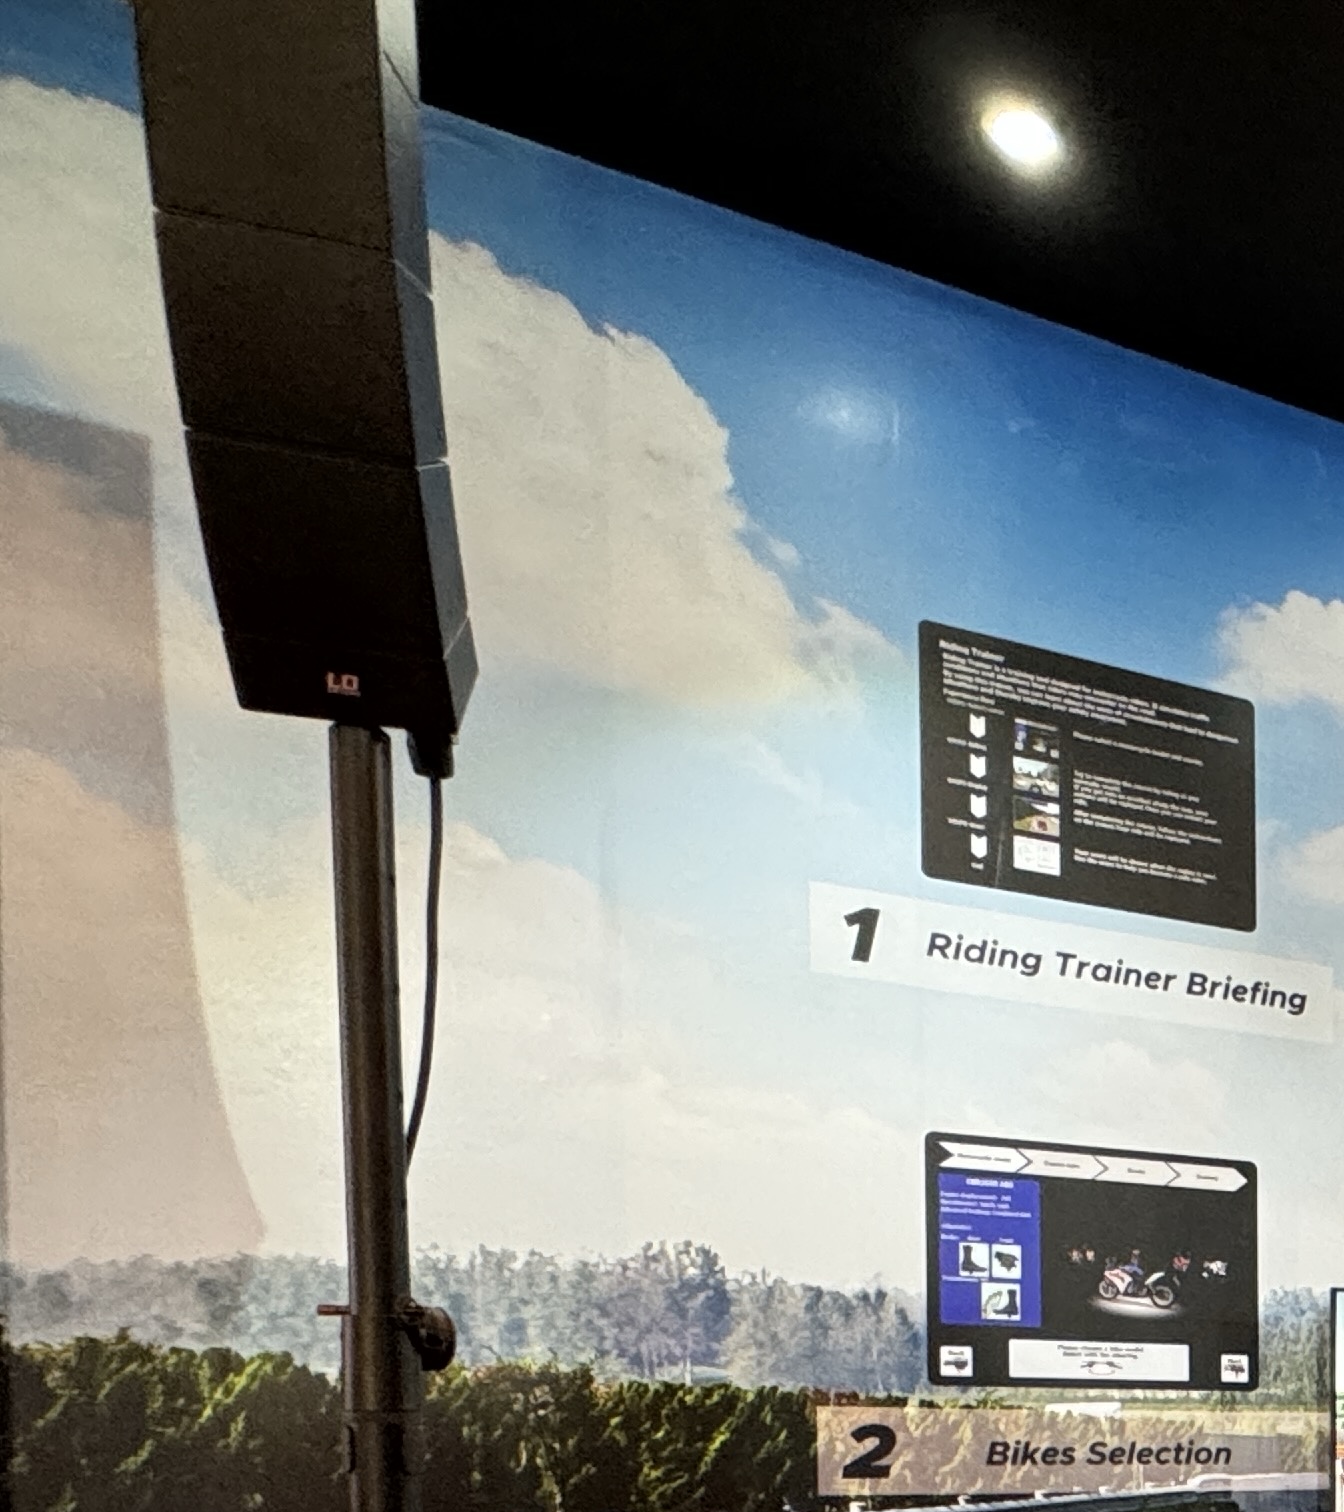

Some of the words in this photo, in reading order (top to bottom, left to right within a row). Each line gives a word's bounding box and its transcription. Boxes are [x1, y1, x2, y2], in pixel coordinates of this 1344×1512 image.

[843, 907, 881, 962] 1
[926, 932, 1042, 977] Riding
[1054, 951, 1178, 993] Trainer
[1186, 973, 1308, 1016] Briefing
[842, 1422, 897, 1480] 2
[985, 1439, 1076, 1467] Bikes
[1086, 1439, 1232, 1467] Selection
